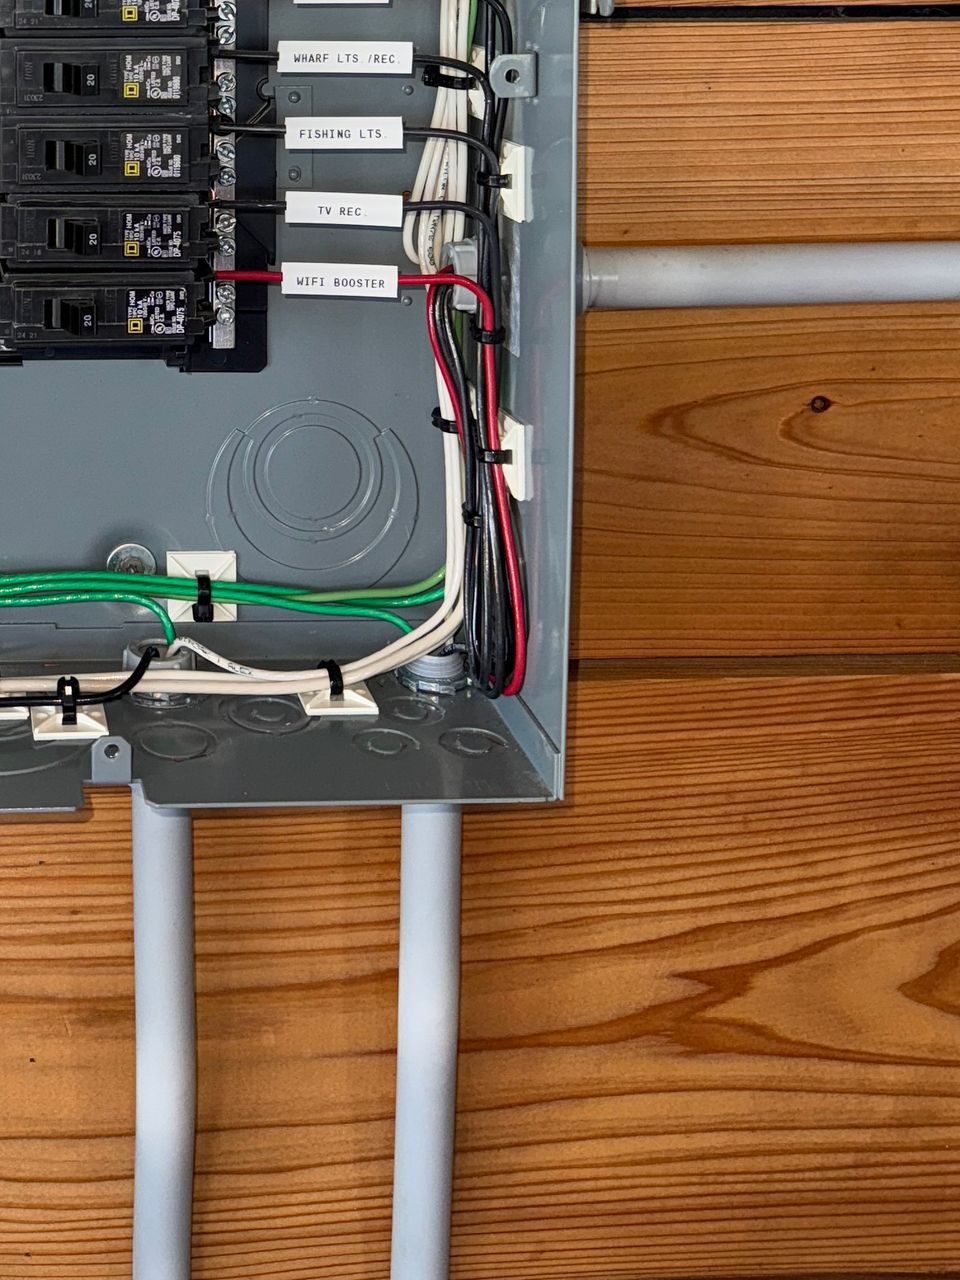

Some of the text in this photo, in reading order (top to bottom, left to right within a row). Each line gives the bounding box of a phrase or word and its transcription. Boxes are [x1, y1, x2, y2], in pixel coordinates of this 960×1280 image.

[293, 53, 329, 63] WHARF
[86, 73, 95, 87] 20
[299, 129, 351, 139] FISHING
[88, 153, 97, 166] 20
[318, 206, 332, 215] TV
[89, 233, 98, 246] 20
[296, 276, 385, 288] WIFI BOOSTER
[83, 314, 92, 327] 20
